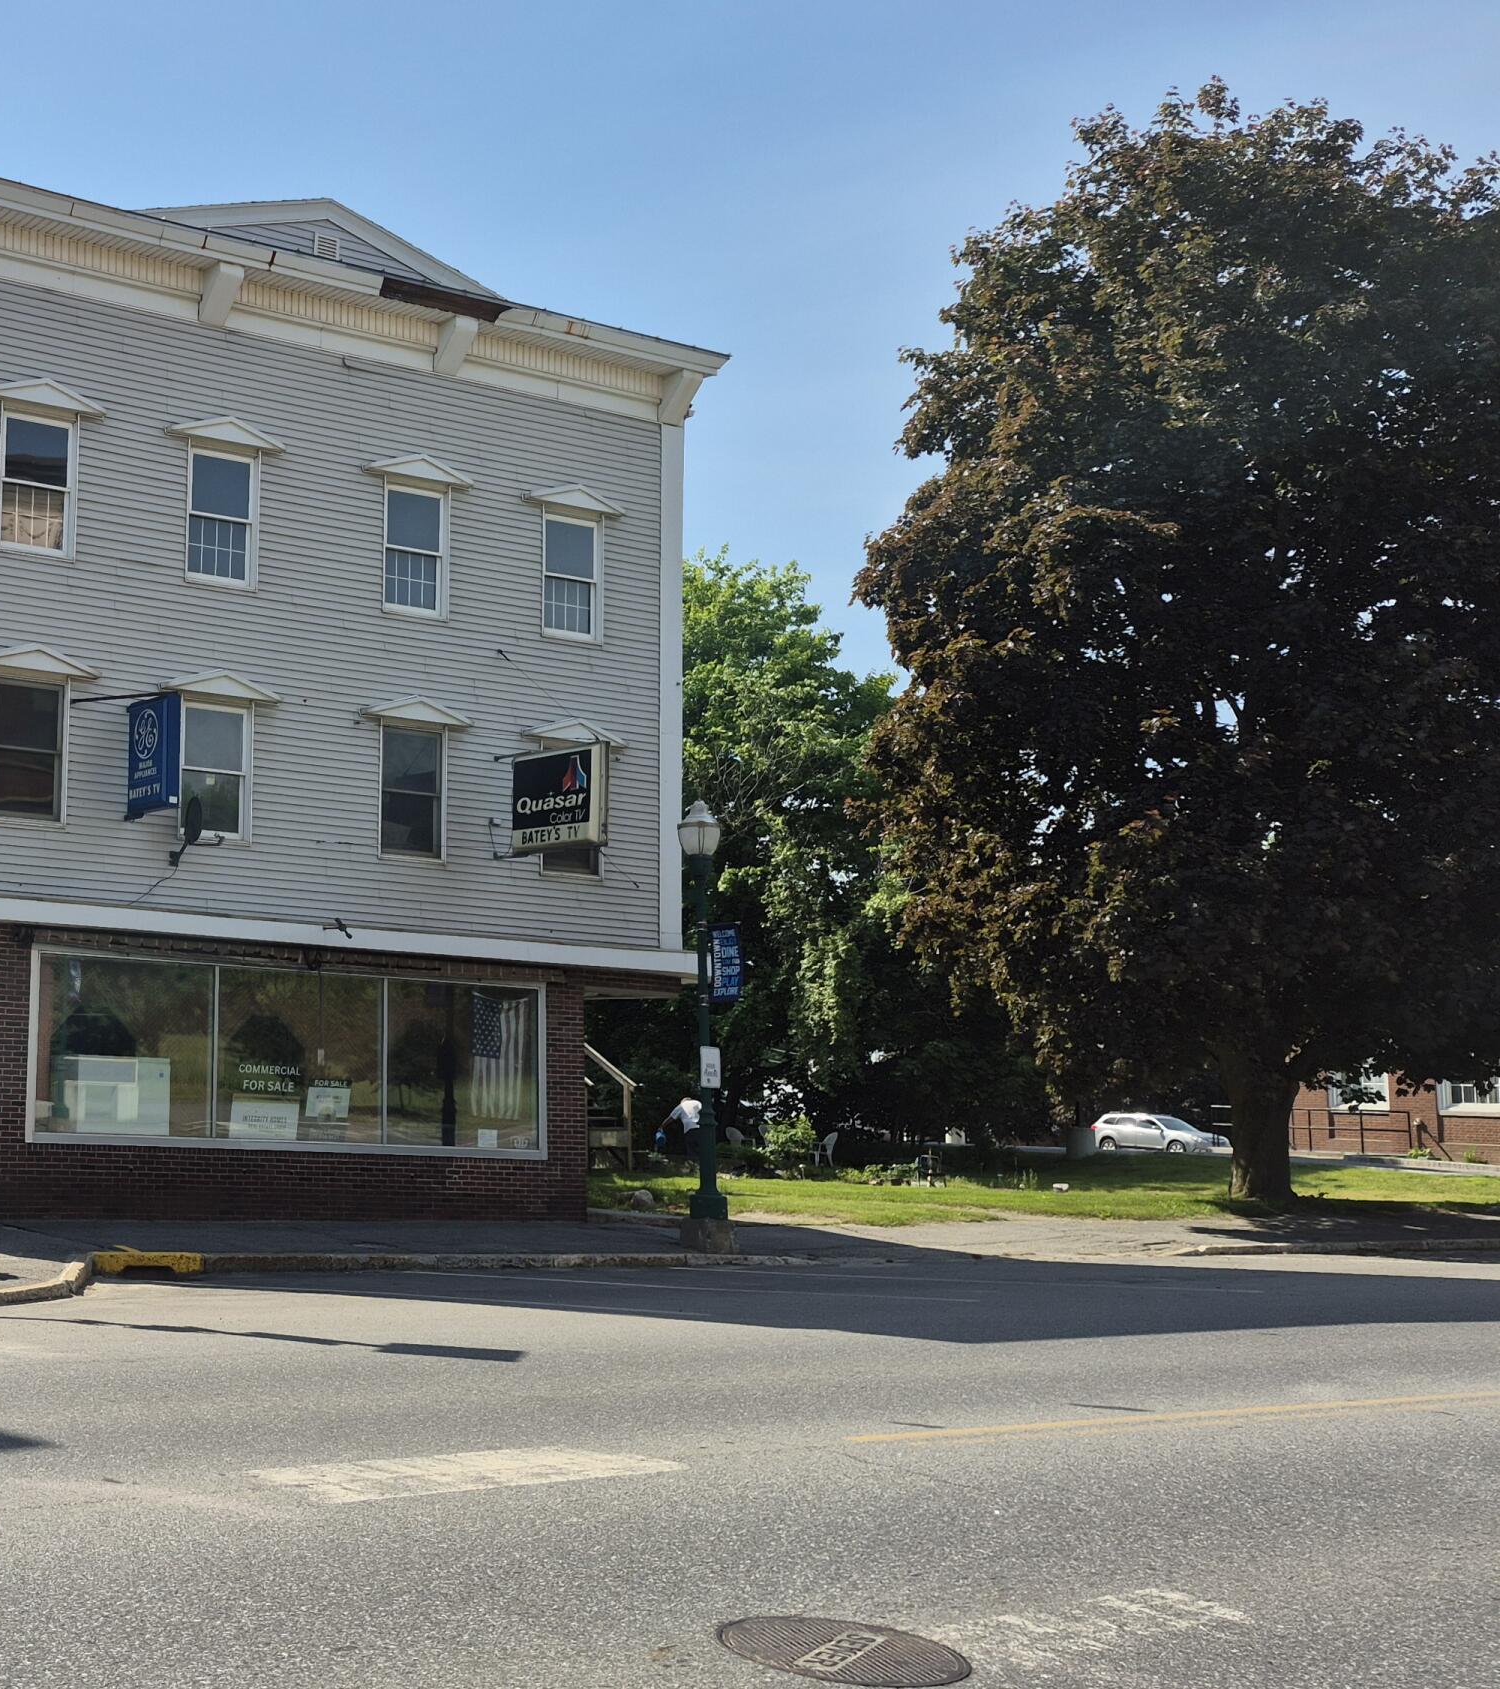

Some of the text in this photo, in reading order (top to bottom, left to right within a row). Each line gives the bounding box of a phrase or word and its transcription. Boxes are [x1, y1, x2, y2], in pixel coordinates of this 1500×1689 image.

[129, 783, 161, 800] BATEY'S TV
[516, 792, 587, 815] Quasar
[549, 809, 586, 824] Color TV
[521, 826, 561, 846] BATEY'S
[721, 946, 739, 958] DINE
[713, 939, 722, 988] DOWNTOWN
[722, 966, 740, 976] SHOP
[722, 976, 739, 987] PLAY
[713, 987, 739, 997] EXPLORE
[238, 1063, 300, 1076] COMMERCIAL
[242, 1079, 295, 1092] FOR SALE
[314, 1079, 348, 1088] FOR SALE
